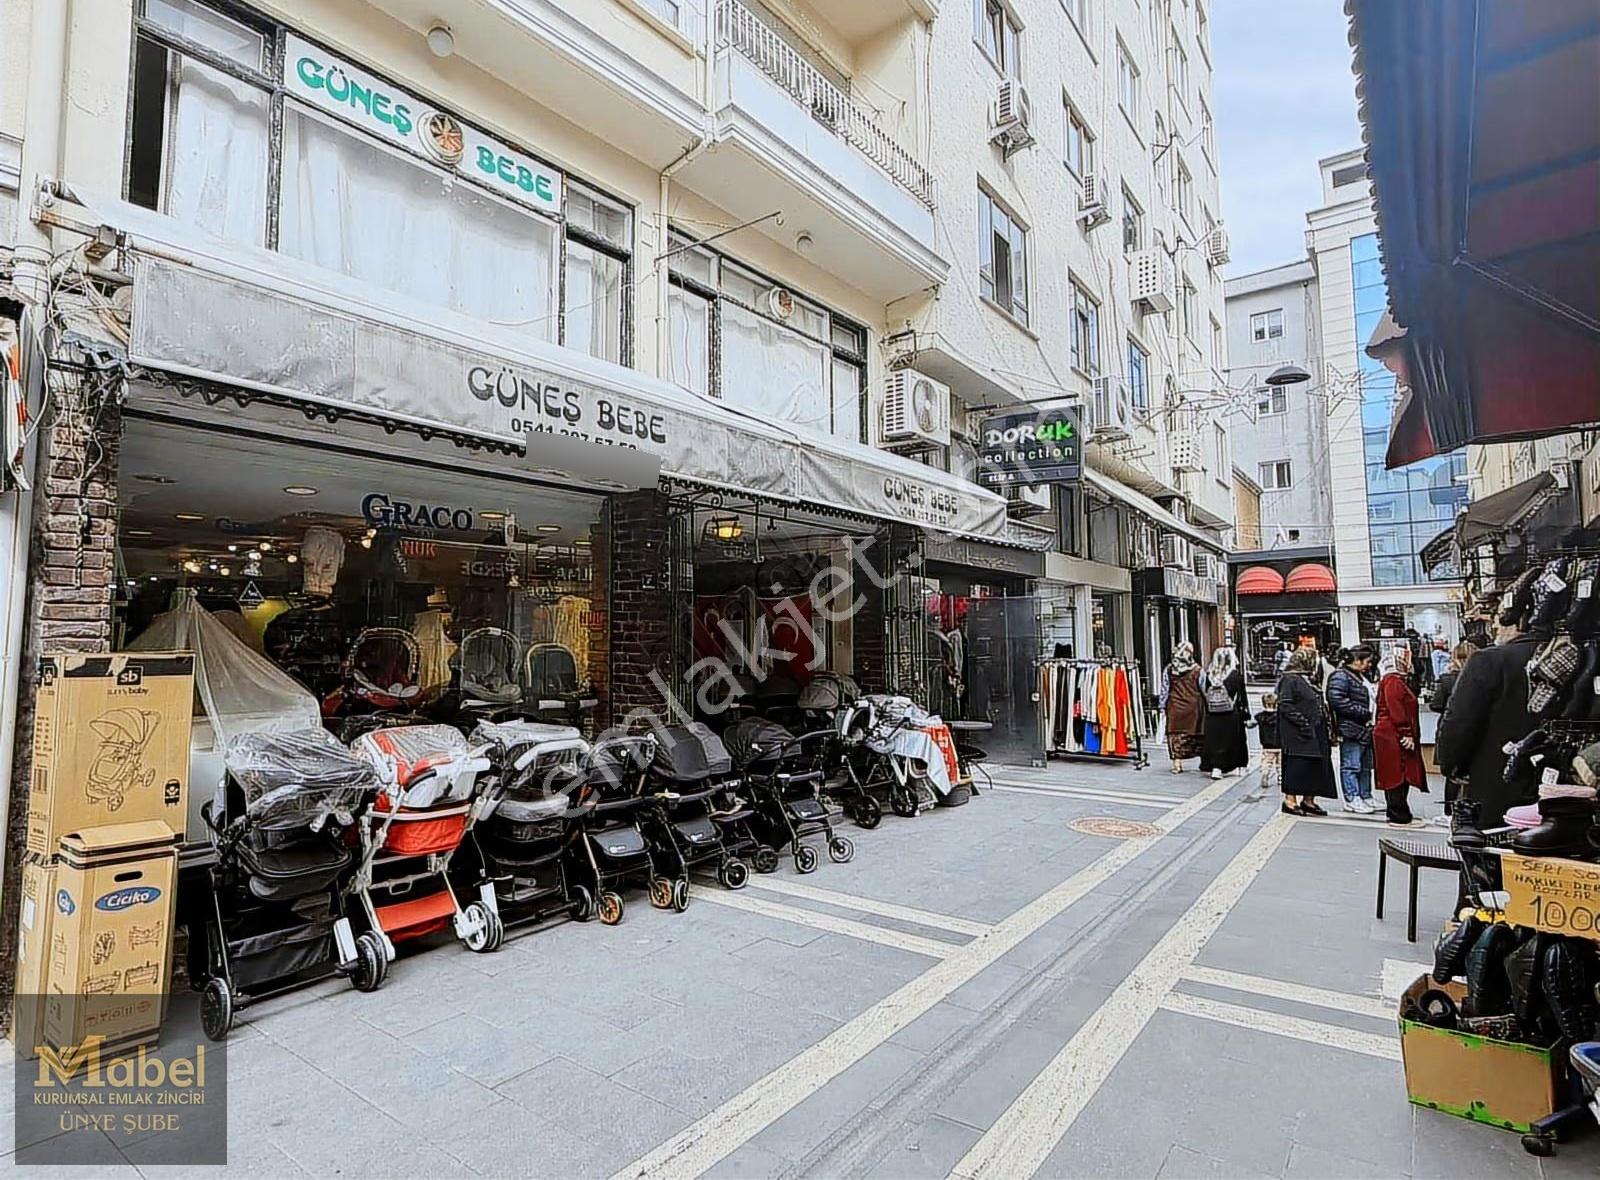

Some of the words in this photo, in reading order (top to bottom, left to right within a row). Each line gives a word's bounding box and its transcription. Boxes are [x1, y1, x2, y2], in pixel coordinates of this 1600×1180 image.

[296, 57, 413, 137] GÜNEŞ
[476, 145, 553, 202] BEBE
[467, 366, 582, 427] GÜNEŞ
[596, 399, 667, 444] BEBE
[984, 446, 1073, 463] collection
[361, 493, 472, 531] GRACO
[930, 489, 958, 515] BEBE
[120, 670, 139, 683] sb
[106, 890, 150, 907] Ciciko
[1529, 895, 1600, 934] 1.00
